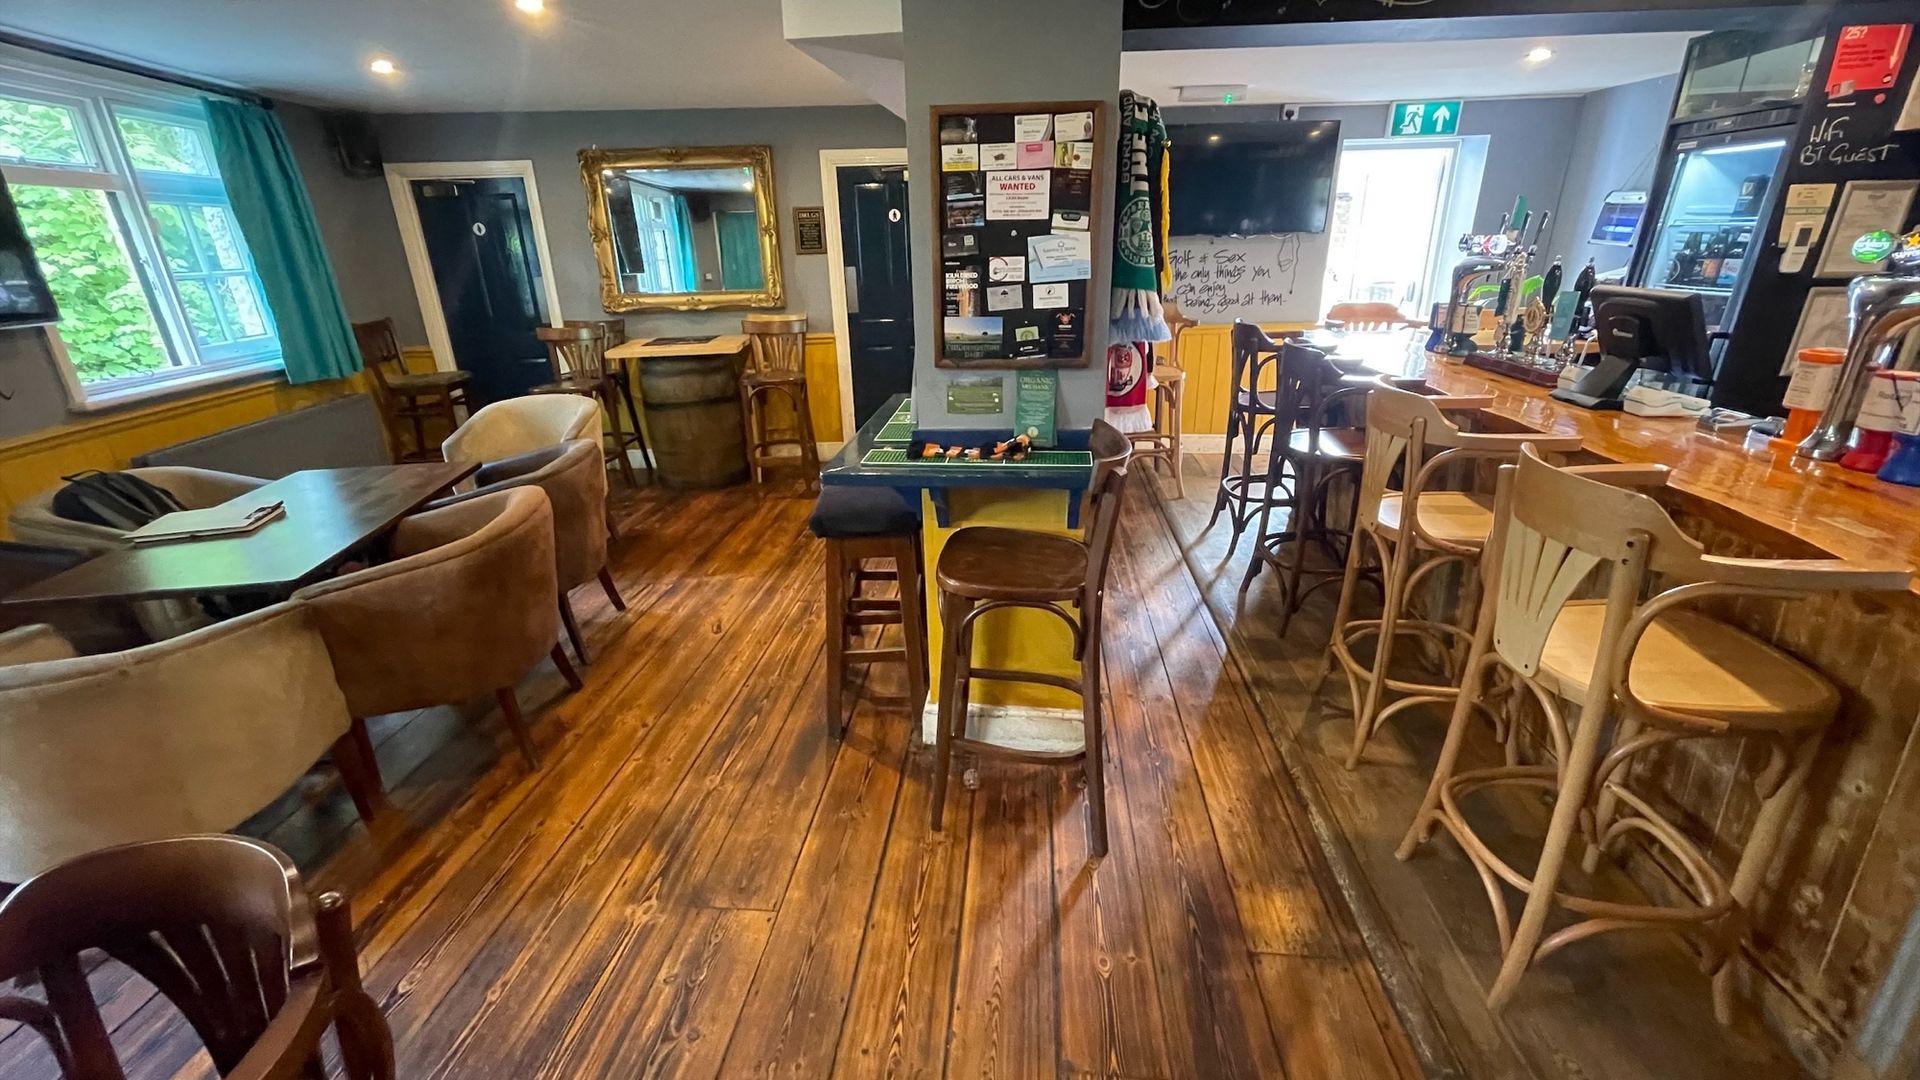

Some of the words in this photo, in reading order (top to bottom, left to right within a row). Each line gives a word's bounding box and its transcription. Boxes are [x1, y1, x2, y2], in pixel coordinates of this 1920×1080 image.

[1845, 26, 1868, 39] 25?
[1122, 96, 1134, 127] AND
[1121, 133, 1132, 184] BORN
[1130, 132, 1149, 196] THE
[1801, 145, 1826, 166] BT
[1000, 182, 1036, 191] WANTED
[1169, 249, 1195, 268] Golf
[1214, 249, 1247, 264] Sex
[1191, 266, 1210, 283] only
[1214, 264, 1247, 284] things
[1199, 281, 1226, 297] enjoy
[1184, 294, 1215, 314] being
[1217, 293, 1239, 314] good
[1240, 292, 1254, 306] at
